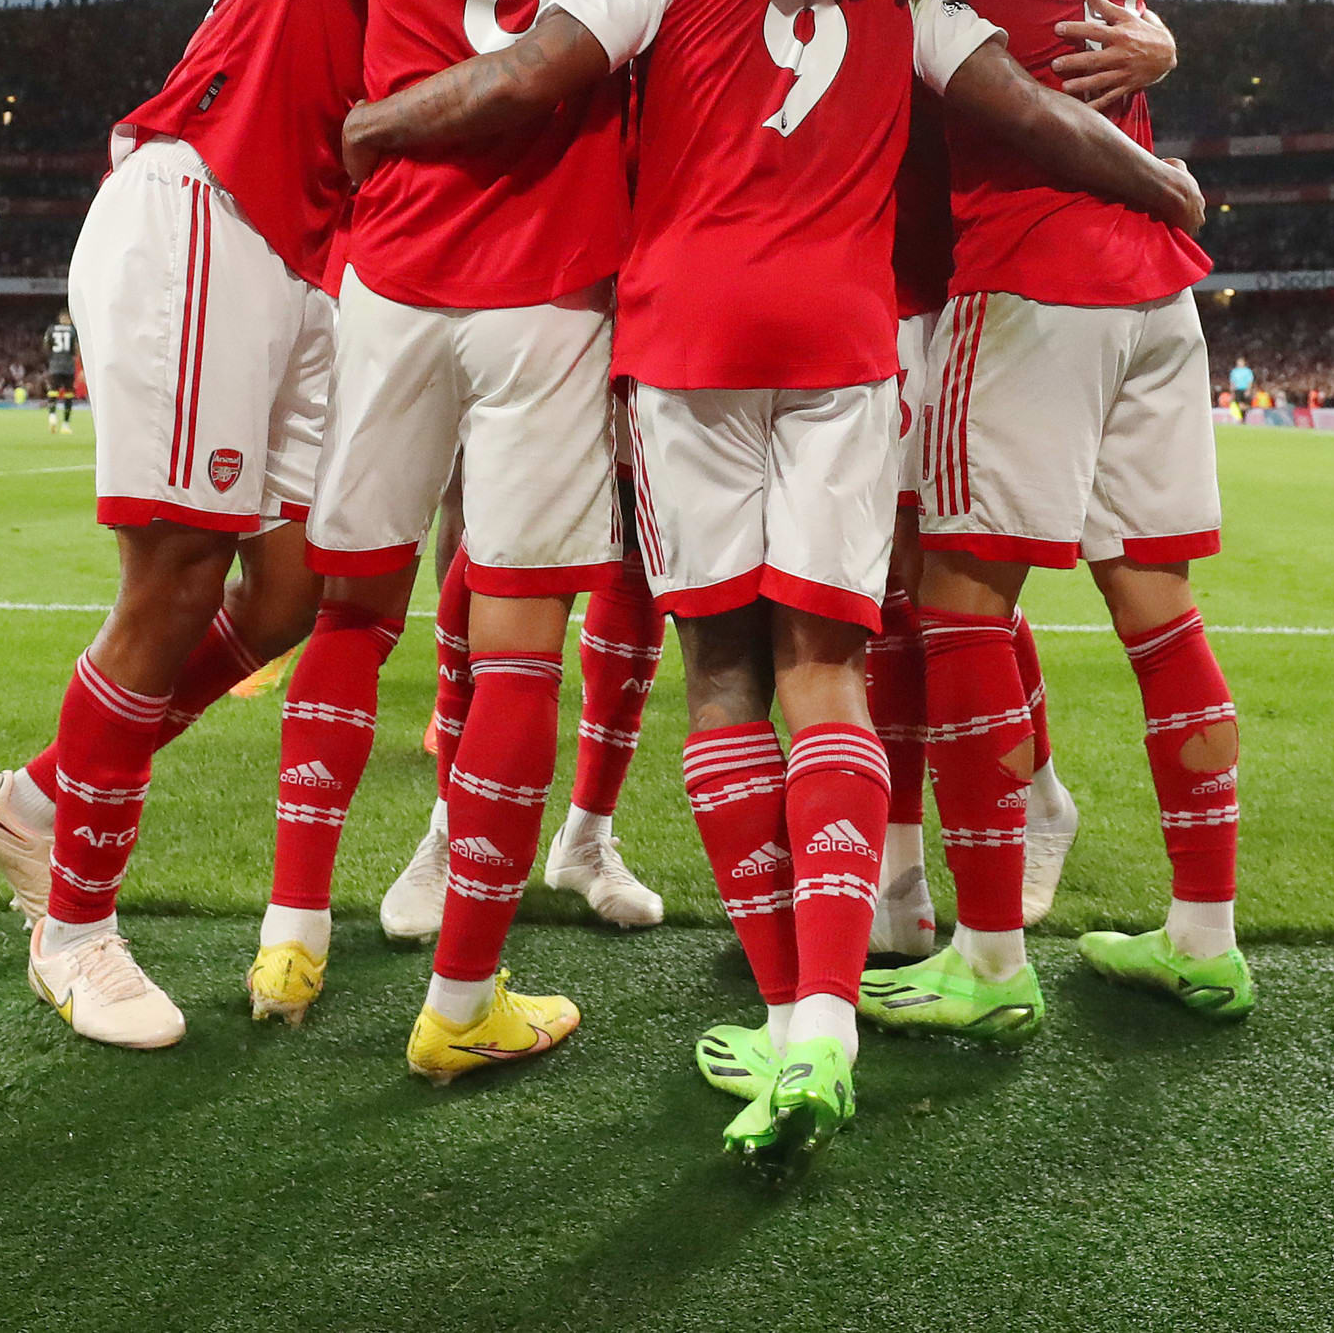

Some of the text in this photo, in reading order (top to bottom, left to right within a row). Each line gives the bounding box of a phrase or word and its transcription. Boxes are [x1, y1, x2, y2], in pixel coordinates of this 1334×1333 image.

[52, 331, 71, 353] 31
[621, 677, 654, 693] AF
[73, 826, 136, 848] AFC
[806, 836, 878, 863] adidas
